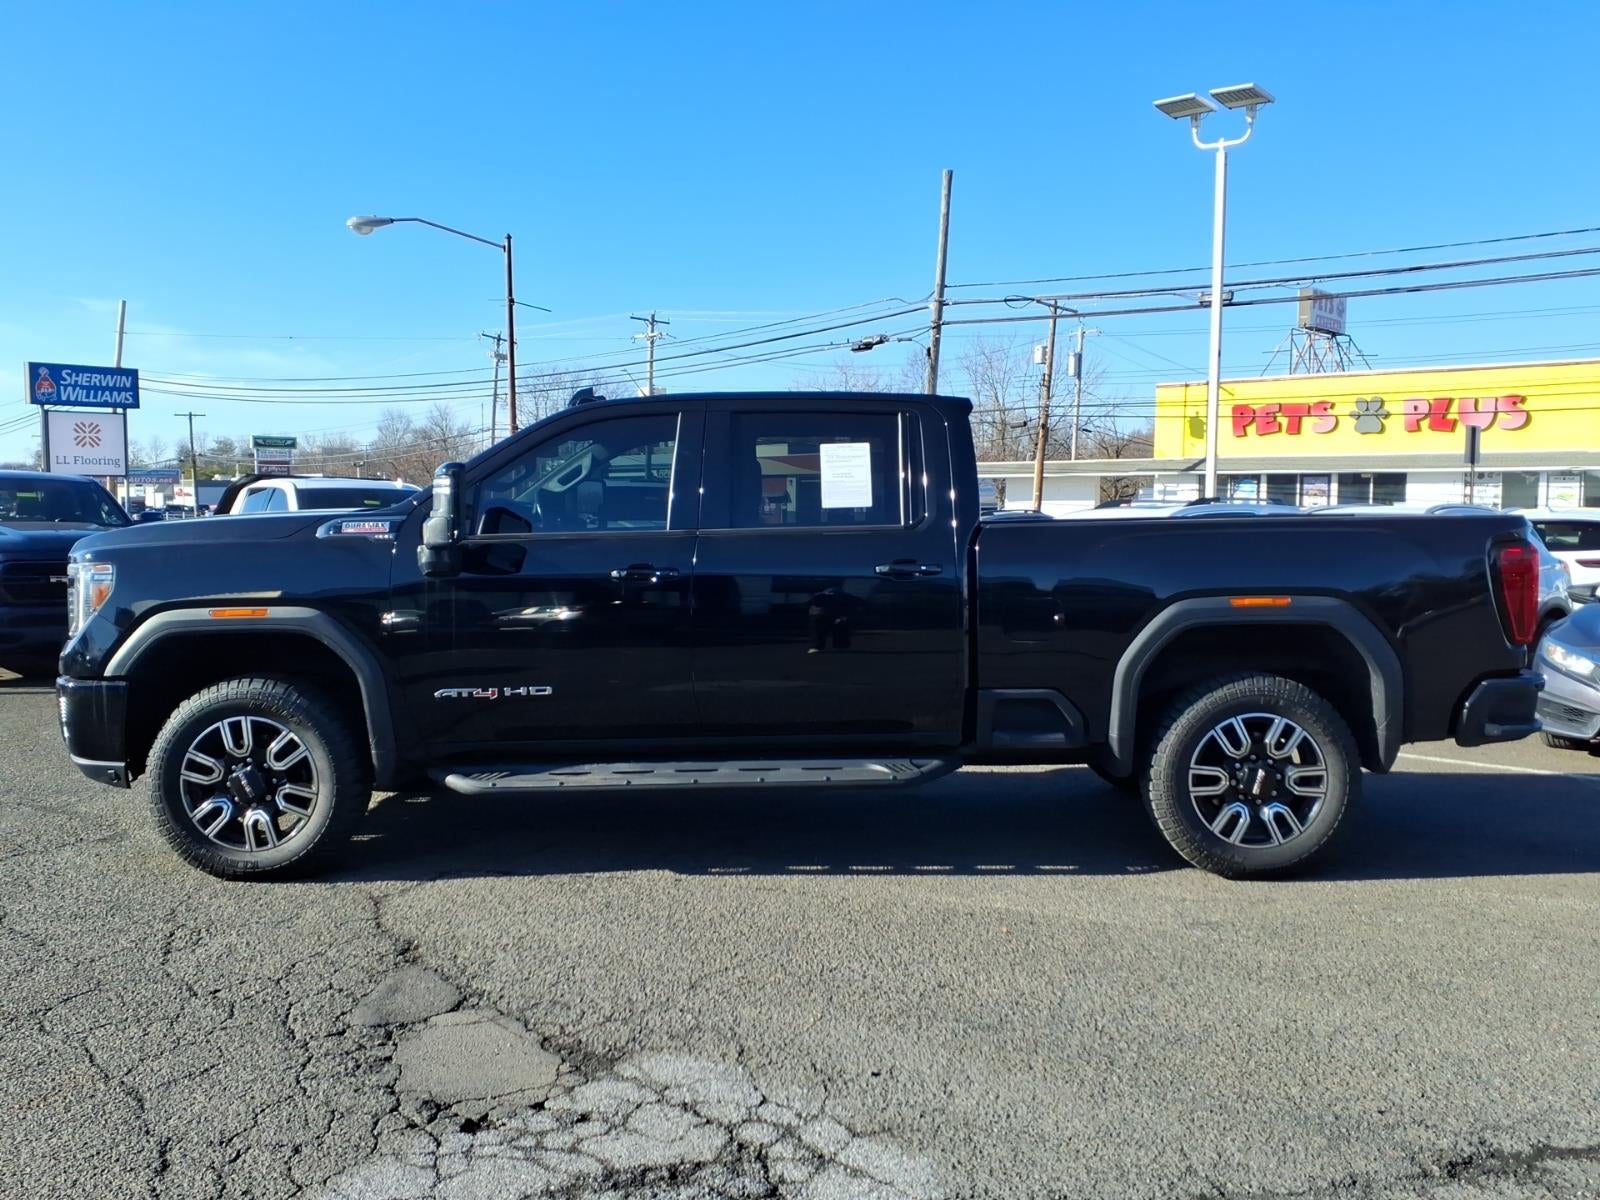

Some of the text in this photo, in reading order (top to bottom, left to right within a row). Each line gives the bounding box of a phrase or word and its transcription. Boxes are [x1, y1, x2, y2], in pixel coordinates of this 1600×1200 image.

[60, 369, 132, 388] SHERWIN
[60, 386, 134, 404] WILLIAMS
[1232, 394, 1529, 437] PETS PLUS
[56, 455, 121, 467] LL Flooring
[434, 687, 552, 700] AT4 HD
